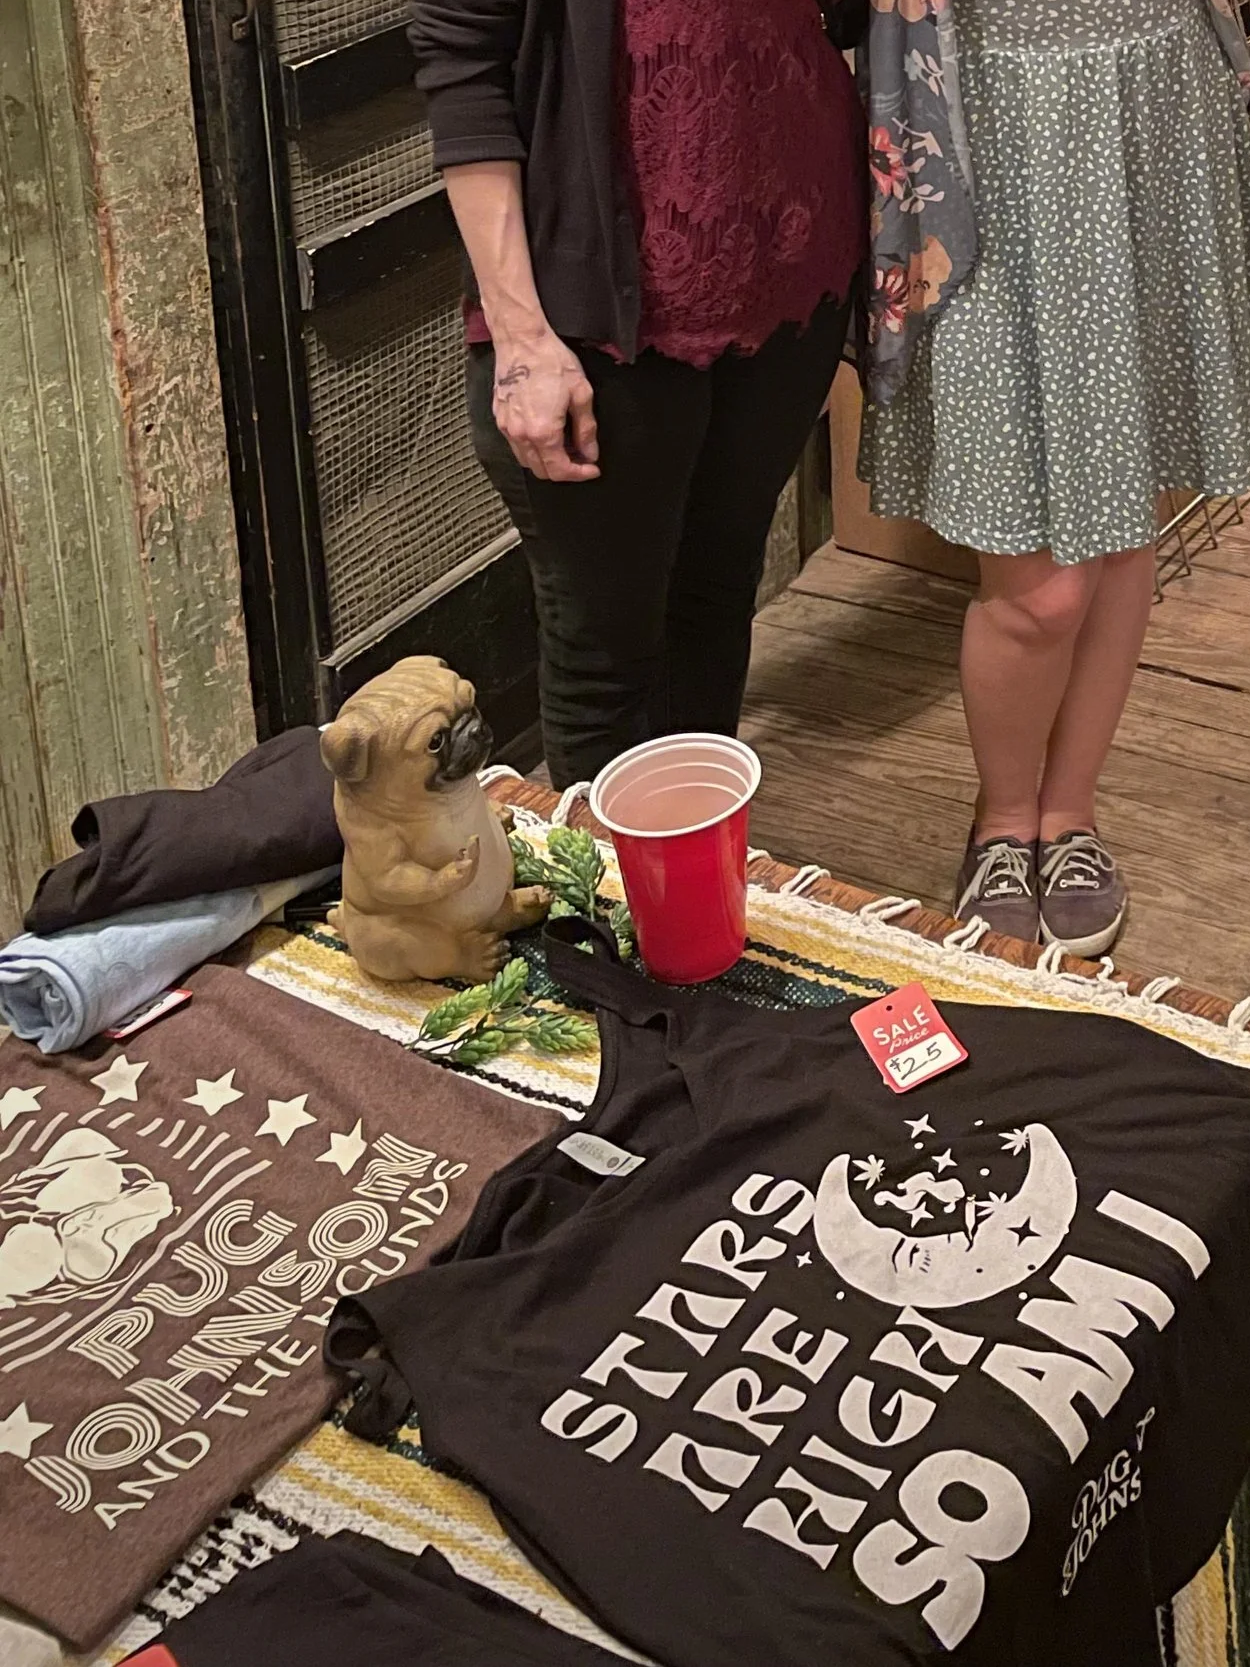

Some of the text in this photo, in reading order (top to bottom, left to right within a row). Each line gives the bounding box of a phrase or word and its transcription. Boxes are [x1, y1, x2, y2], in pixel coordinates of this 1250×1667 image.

[872, 1005, 931, 1046] SALE
[889, 1041, 942, 1081] $25
[23, 1133, 437, 1514] JOHNSON
[67, 1198, 298, 1380] PUG
[541, 1172, 815, 1462] STARS
[93, 1430, 211, 1531] AND
[202, 1333, 317, 1420] THE
[643, 1308, 850, 1513] ARE
[851, 1190, 1211, 1651] SO AM I
[1071, 1449, 1132, 1530] PUG
[1062, 1465, 1142, 1597] JOHNS
